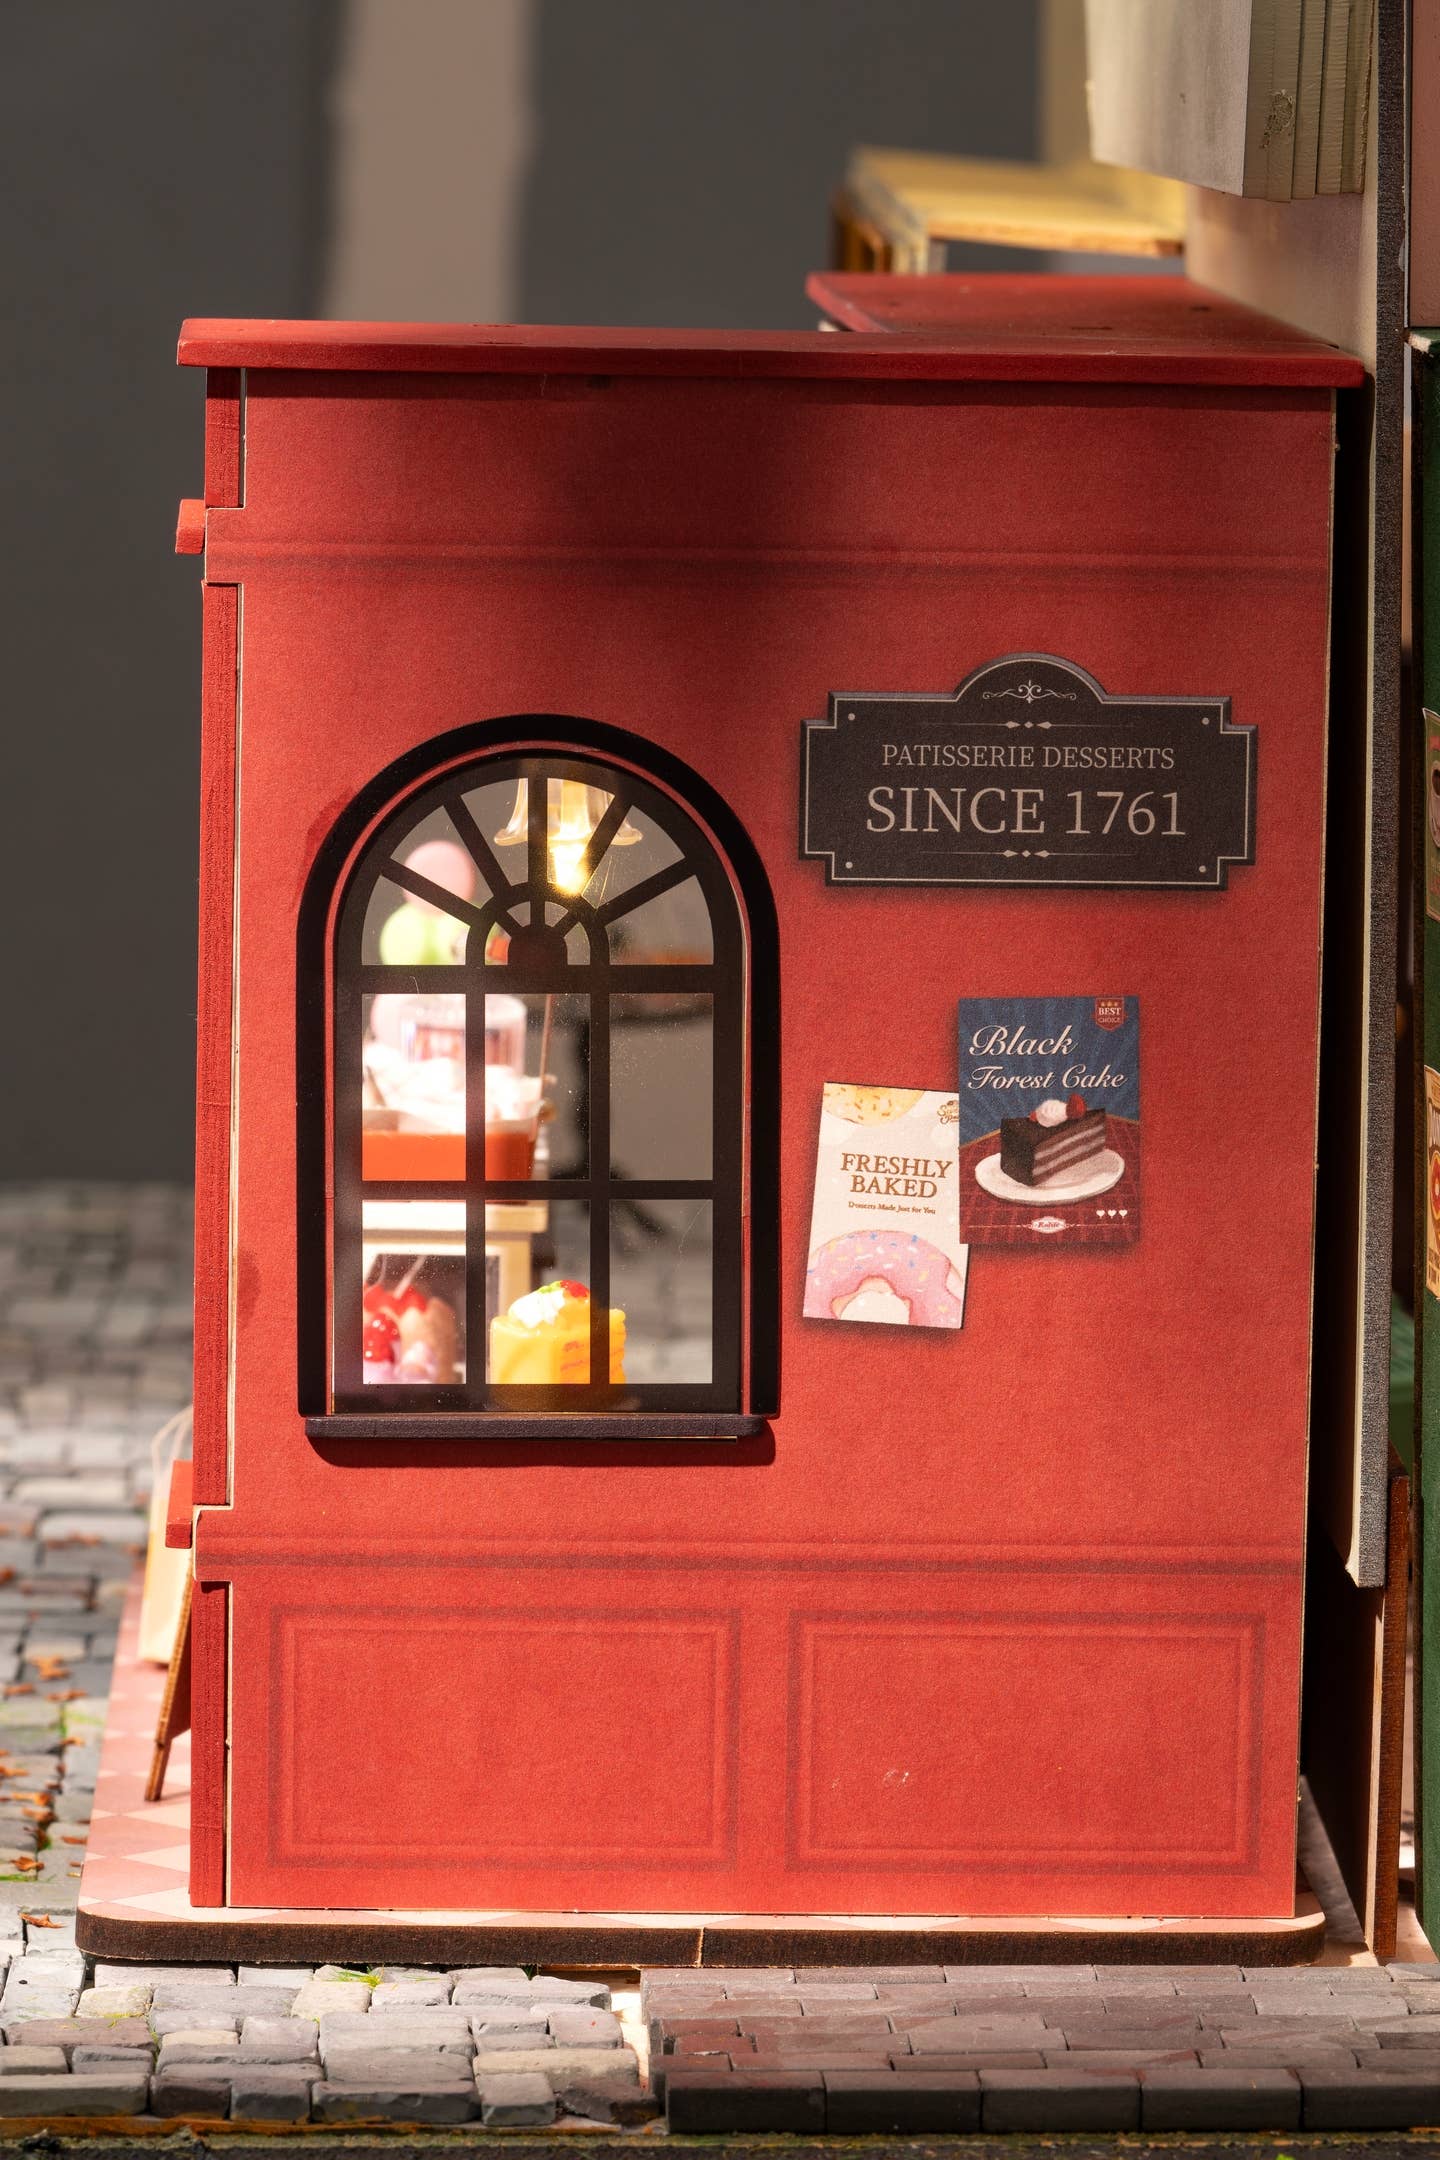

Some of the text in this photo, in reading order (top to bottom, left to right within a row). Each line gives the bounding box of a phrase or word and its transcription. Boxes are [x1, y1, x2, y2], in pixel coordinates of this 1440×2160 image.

[881, 743, 1175, 770] PATISSERIE DESSERTS
[865, 786, 1187, 836] SINCE 1761
[1098, 1007, 1121, 1016] BEST
[968, 1024, 1078, 1057] Black
[967, 1063, 1128, 1091] Forest Cake
[840, 1152, 953, 1179] FRESHLY
[850, 1175, 938, 1199] BAKED
[878, 1203, 896, 1211] Made
[896, 1205, 911, 1213] Just
[911, 1205, 922, 1214] for
[922, 1207, 936, 1215] You
